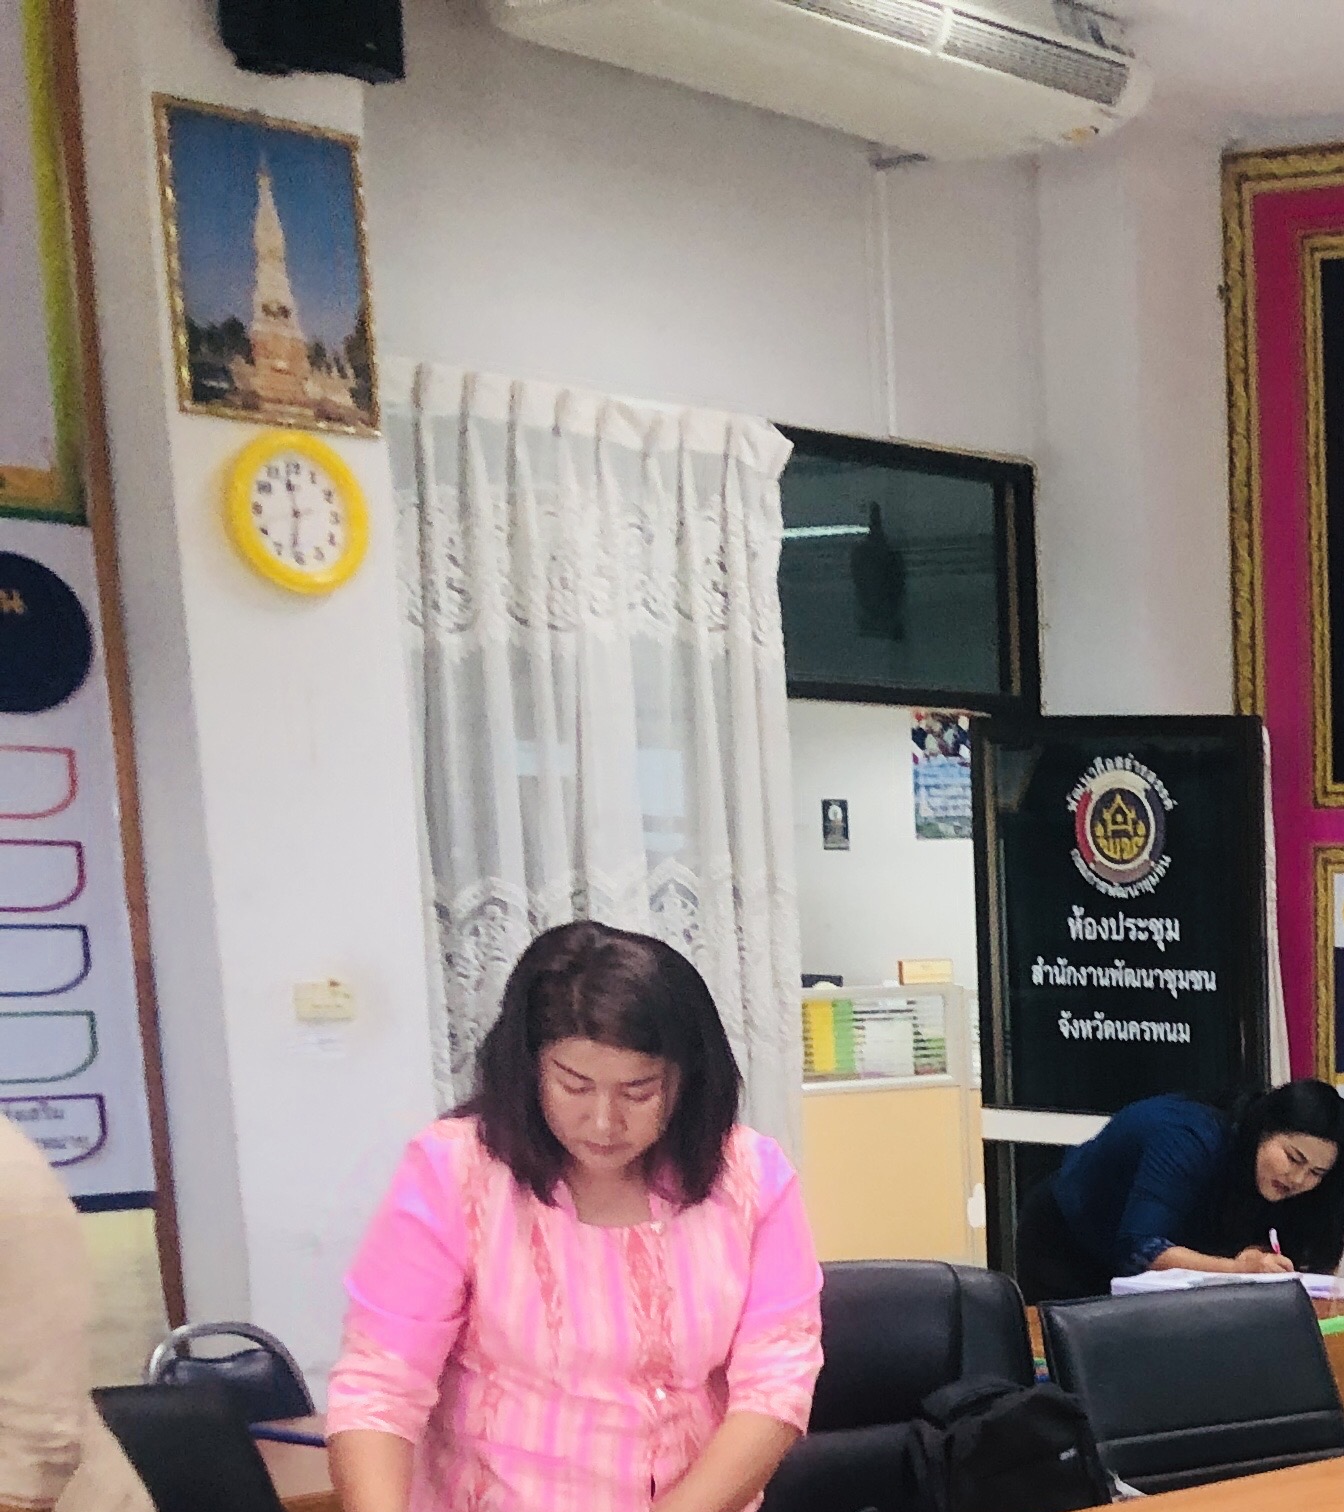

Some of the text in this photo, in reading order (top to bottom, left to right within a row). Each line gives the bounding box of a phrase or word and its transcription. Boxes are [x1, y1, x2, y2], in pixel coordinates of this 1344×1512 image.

[1067, 905, 1180, 952] ห้องประชุม
[1031, 956, 1216, 999] สำนักงานพัฒนาชุมชน
[1058, 1010, 1191, 1044] จังหวัดนครพนม
